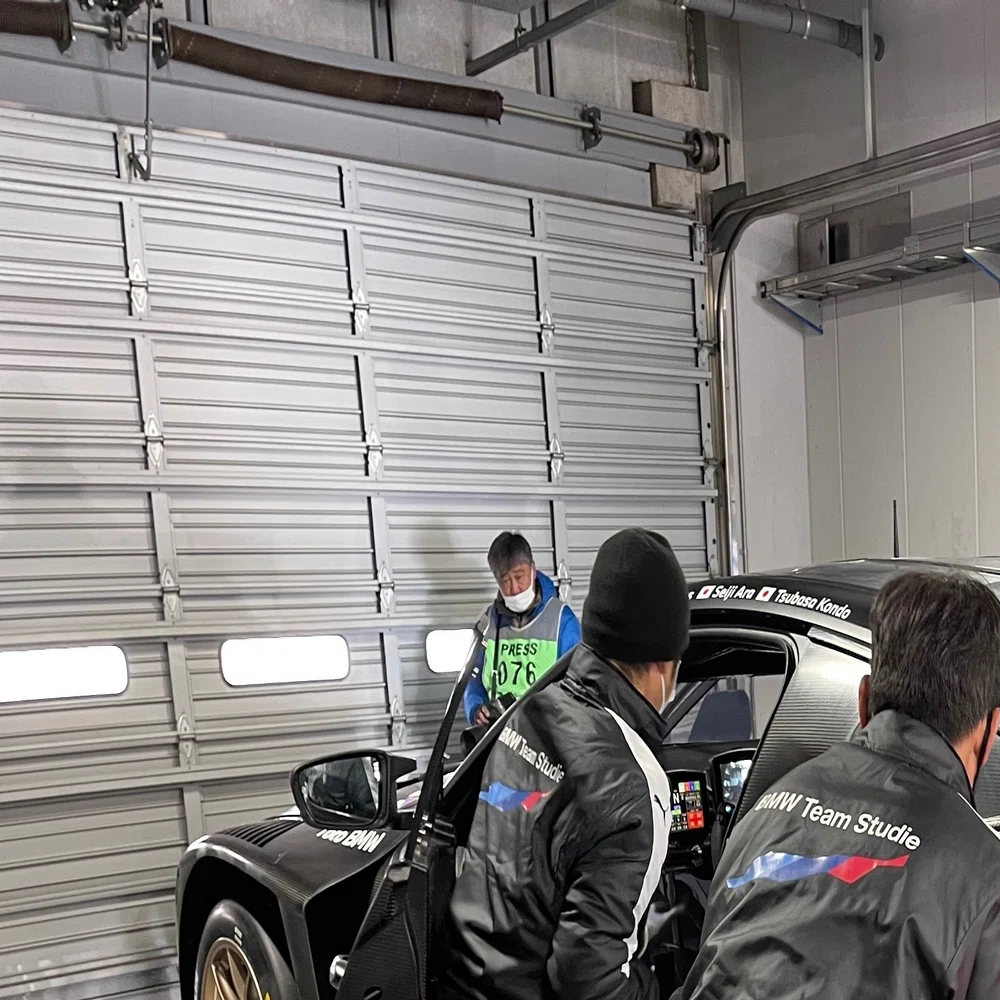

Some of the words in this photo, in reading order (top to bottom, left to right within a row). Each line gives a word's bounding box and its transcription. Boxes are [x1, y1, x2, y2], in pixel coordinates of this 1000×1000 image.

[712, 585, 736, 601] Seiji
[736, 585, 756, 600] Ara
[774, 589, 815, 609] Tsubasa
[816, 598, 852, 619] Kondo
[501, 642, 538, 657] PRESS
[498, 660, 536, 686] 076
[519, 737, 537, 766] Team
[535, 751, 565, 783] Studie
[755, 791, 803, 813] BMW
[801, 797, 852, 830] Team
[854, 813, 921, 850] Studie
